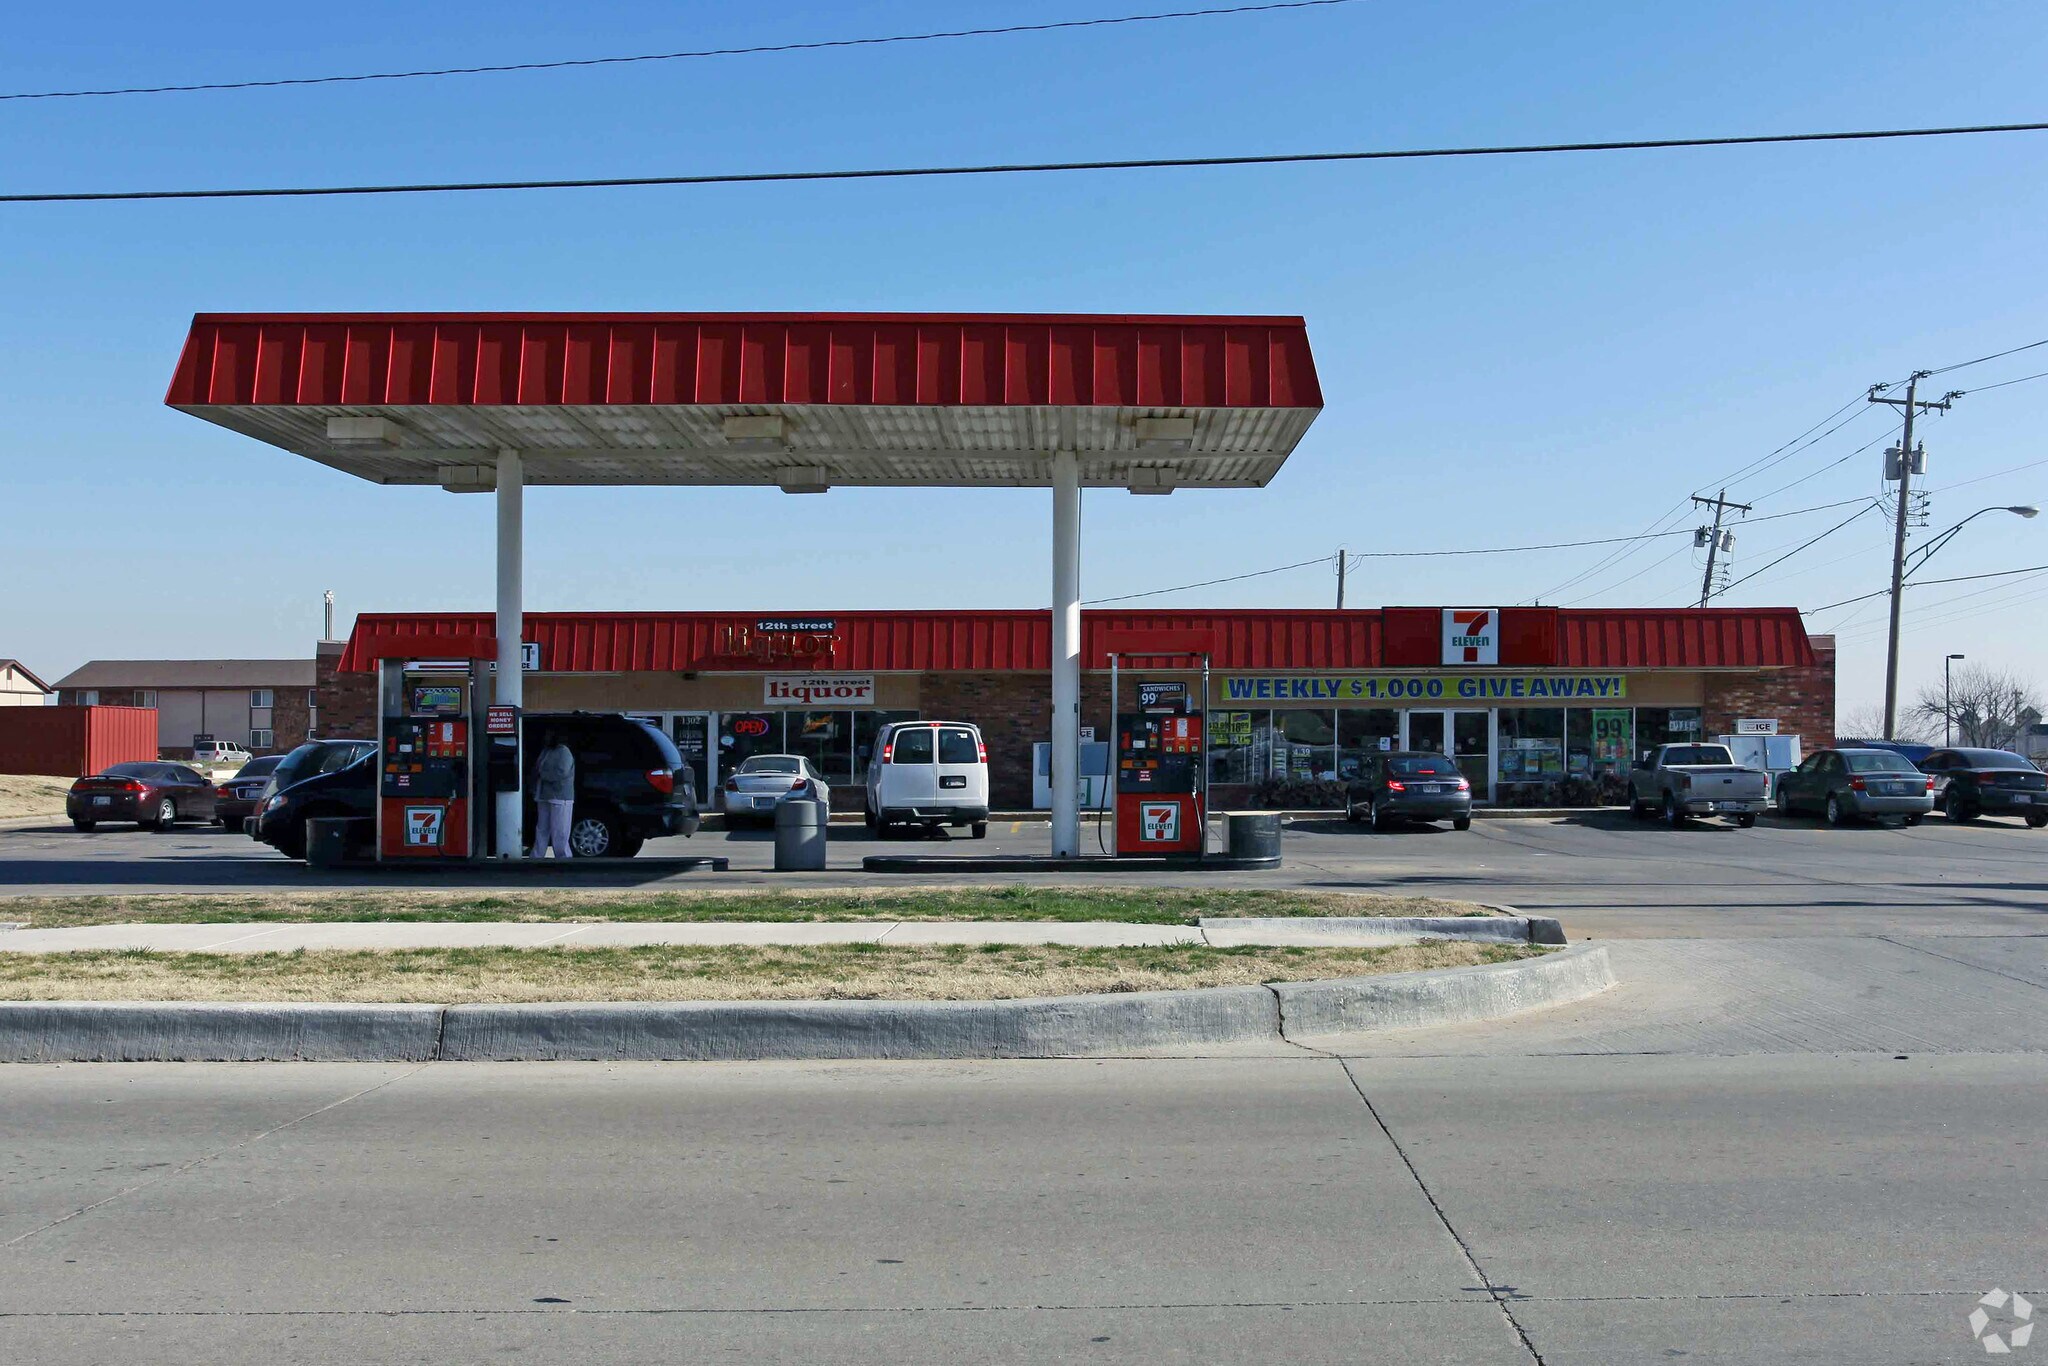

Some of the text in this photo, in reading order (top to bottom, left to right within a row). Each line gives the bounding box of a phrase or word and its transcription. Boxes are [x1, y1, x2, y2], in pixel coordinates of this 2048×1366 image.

[757, 622, 834, 630] 12th street
[1453, 611, 1489, 662] 7
[720, 626, 841, 663] liquor
[769, 682, 870, 703] liquor
[1228, 678, 1620, 698] WEEKLY $1,000 GIVEAWAY!
[735, 720, 763, 733] OPEN
[1080, 730, 1092, 738] CE
[413, 813, 435, 843] 7
[1148, 809, 1171, 839] 7
